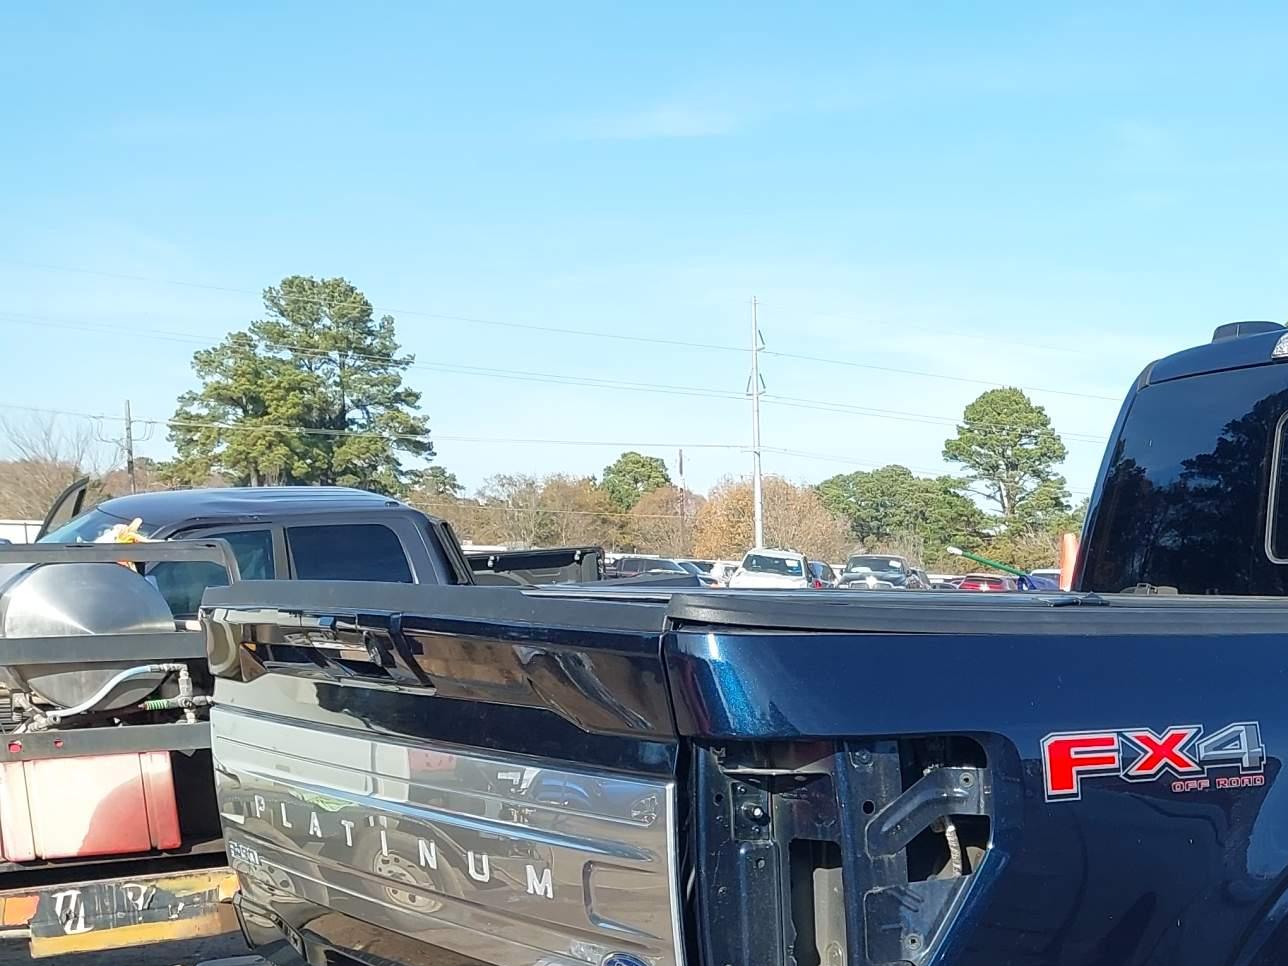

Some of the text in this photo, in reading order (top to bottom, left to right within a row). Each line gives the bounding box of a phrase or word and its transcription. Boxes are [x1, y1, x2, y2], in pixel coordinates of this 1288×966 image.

[1041, 721, 1266, 802] FX4
[1171, 775, 1265, 792] OFF ROAD
[253, 794, 555, 899] PLATINUM
